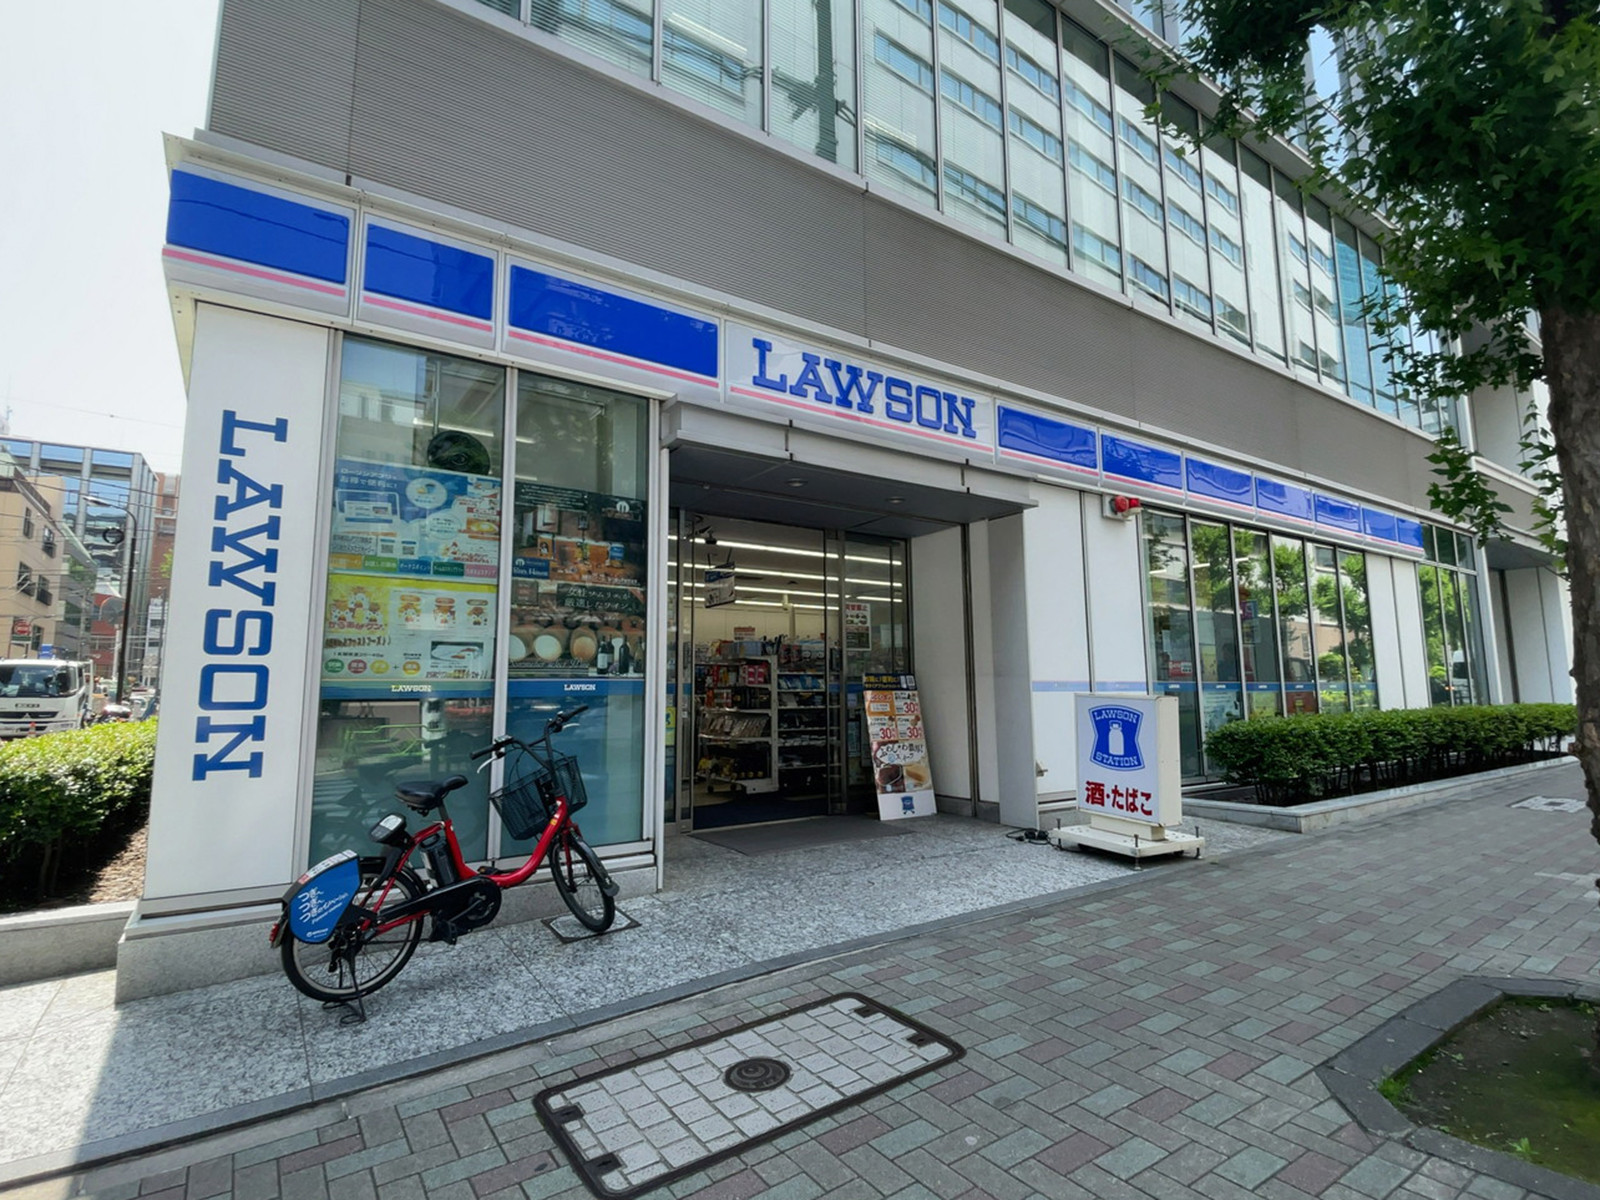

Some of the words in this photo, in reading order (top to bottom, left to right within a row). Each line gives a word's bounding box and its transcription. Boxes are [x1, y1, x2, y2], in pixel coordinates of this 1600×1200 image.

[752, 337, 977, 439] LAWSON
[192, 409, 288, 781] LAWSON
[391, 684, 432, 693] LAWSON
[563, 683, 596, 691] LAWSON
[1094, 710, 1138, 723] LAWSON
[1095, 752, 1138, 766] STATION
[1085, 781, 1153, 816] 酒・たばこ
